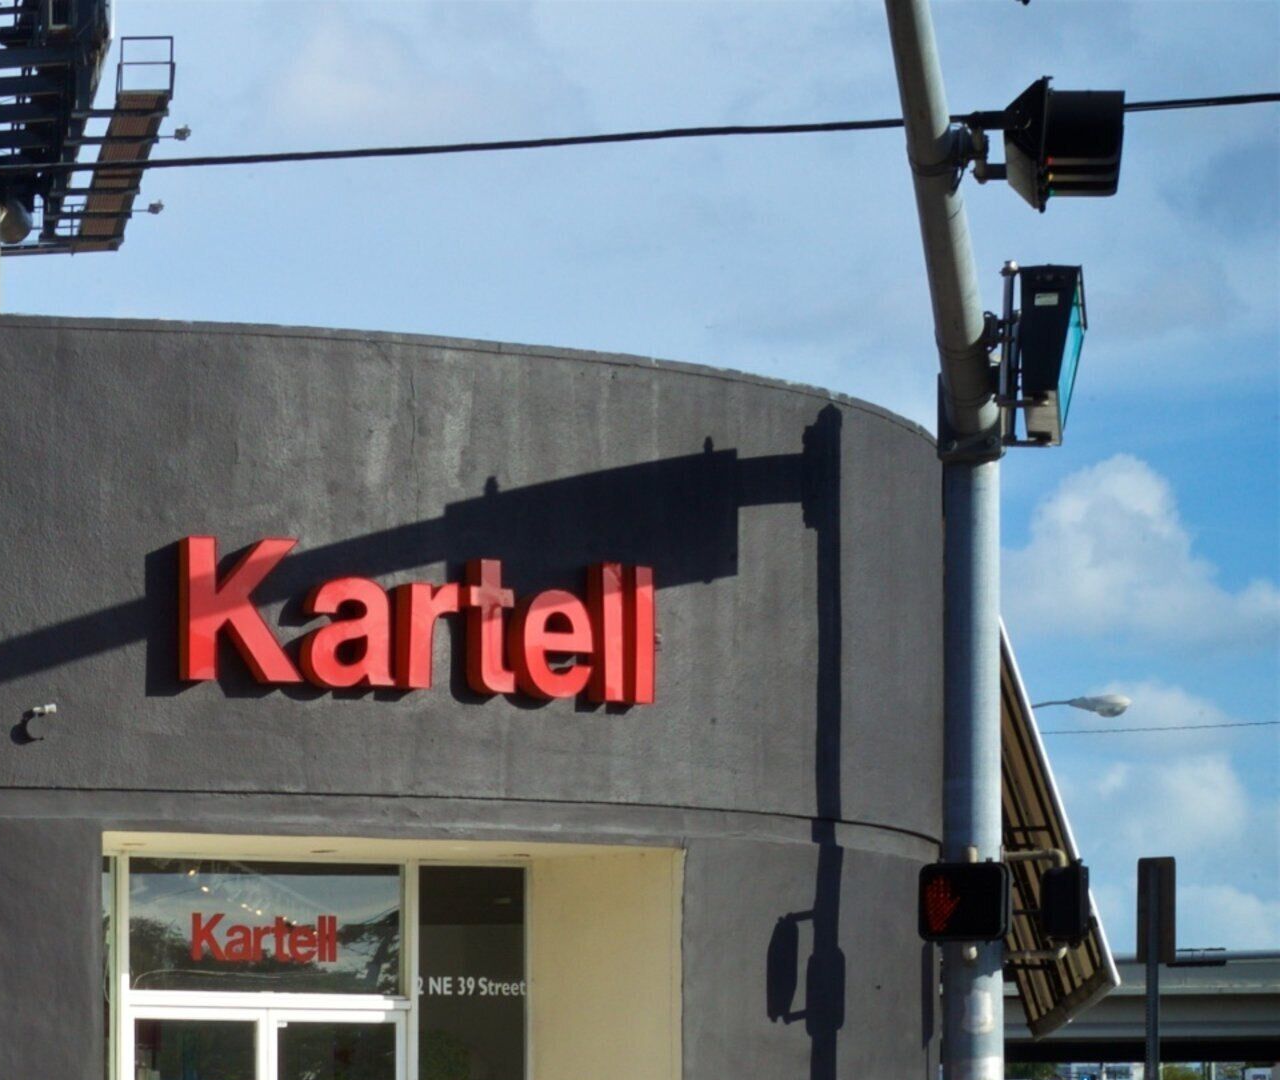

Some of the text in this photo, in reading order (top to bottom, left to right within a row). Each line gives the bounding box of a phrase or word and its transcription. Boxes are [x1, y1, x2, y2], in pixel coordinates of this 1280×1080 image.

[179, 534, 655, 704] Kartell
[191, 911, 337, 963] Kartell
[428, 976, 453, 996] NE
[457, 976, 476, 996] 39
[478, 976, 527, 996] Street
